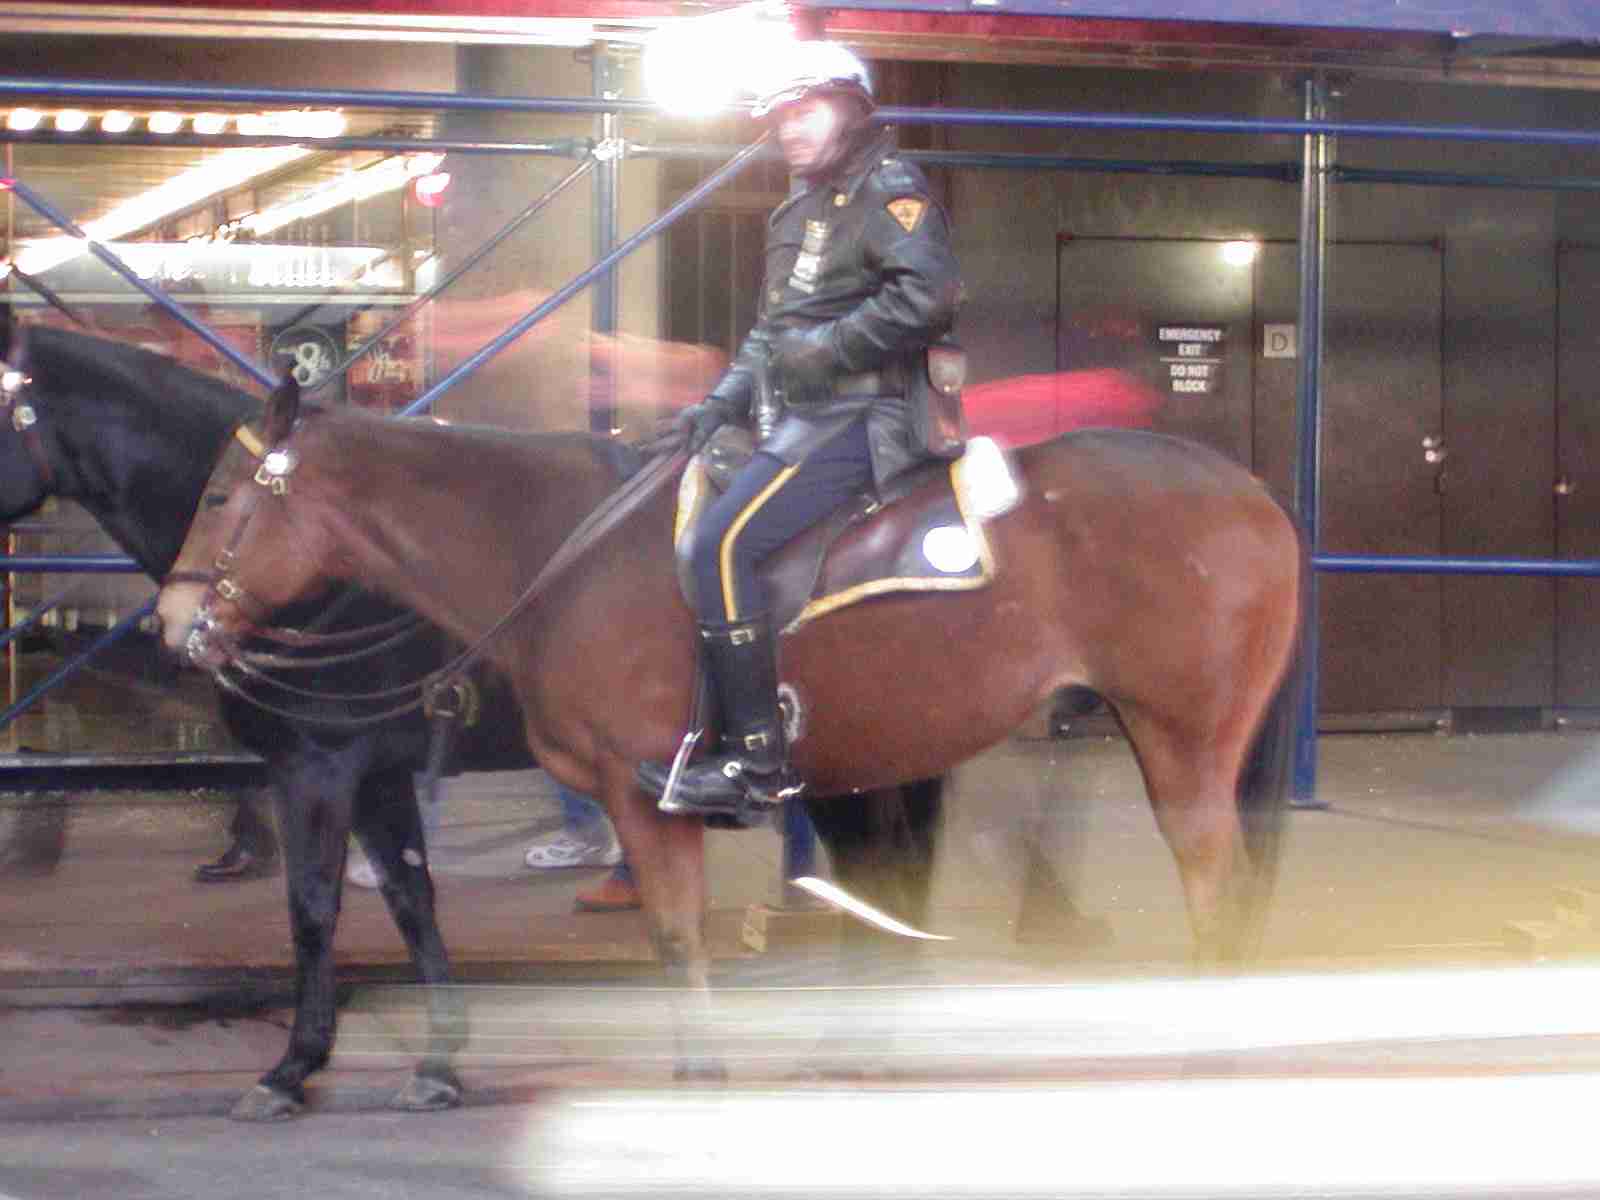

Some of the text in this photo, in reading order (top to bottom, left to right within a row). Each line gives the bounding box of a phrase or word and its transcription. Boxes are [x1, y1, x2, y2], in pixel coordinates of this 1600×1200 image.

[1159, 328, 1222, 341] EMERGENCY
[1271, 332, 1288, 351] D
[1177, 343, 1202, 356] EXIT
[1170, 364, 1208, 377] DO NOT
[1172, 380, 1207, 392] BLOCK
